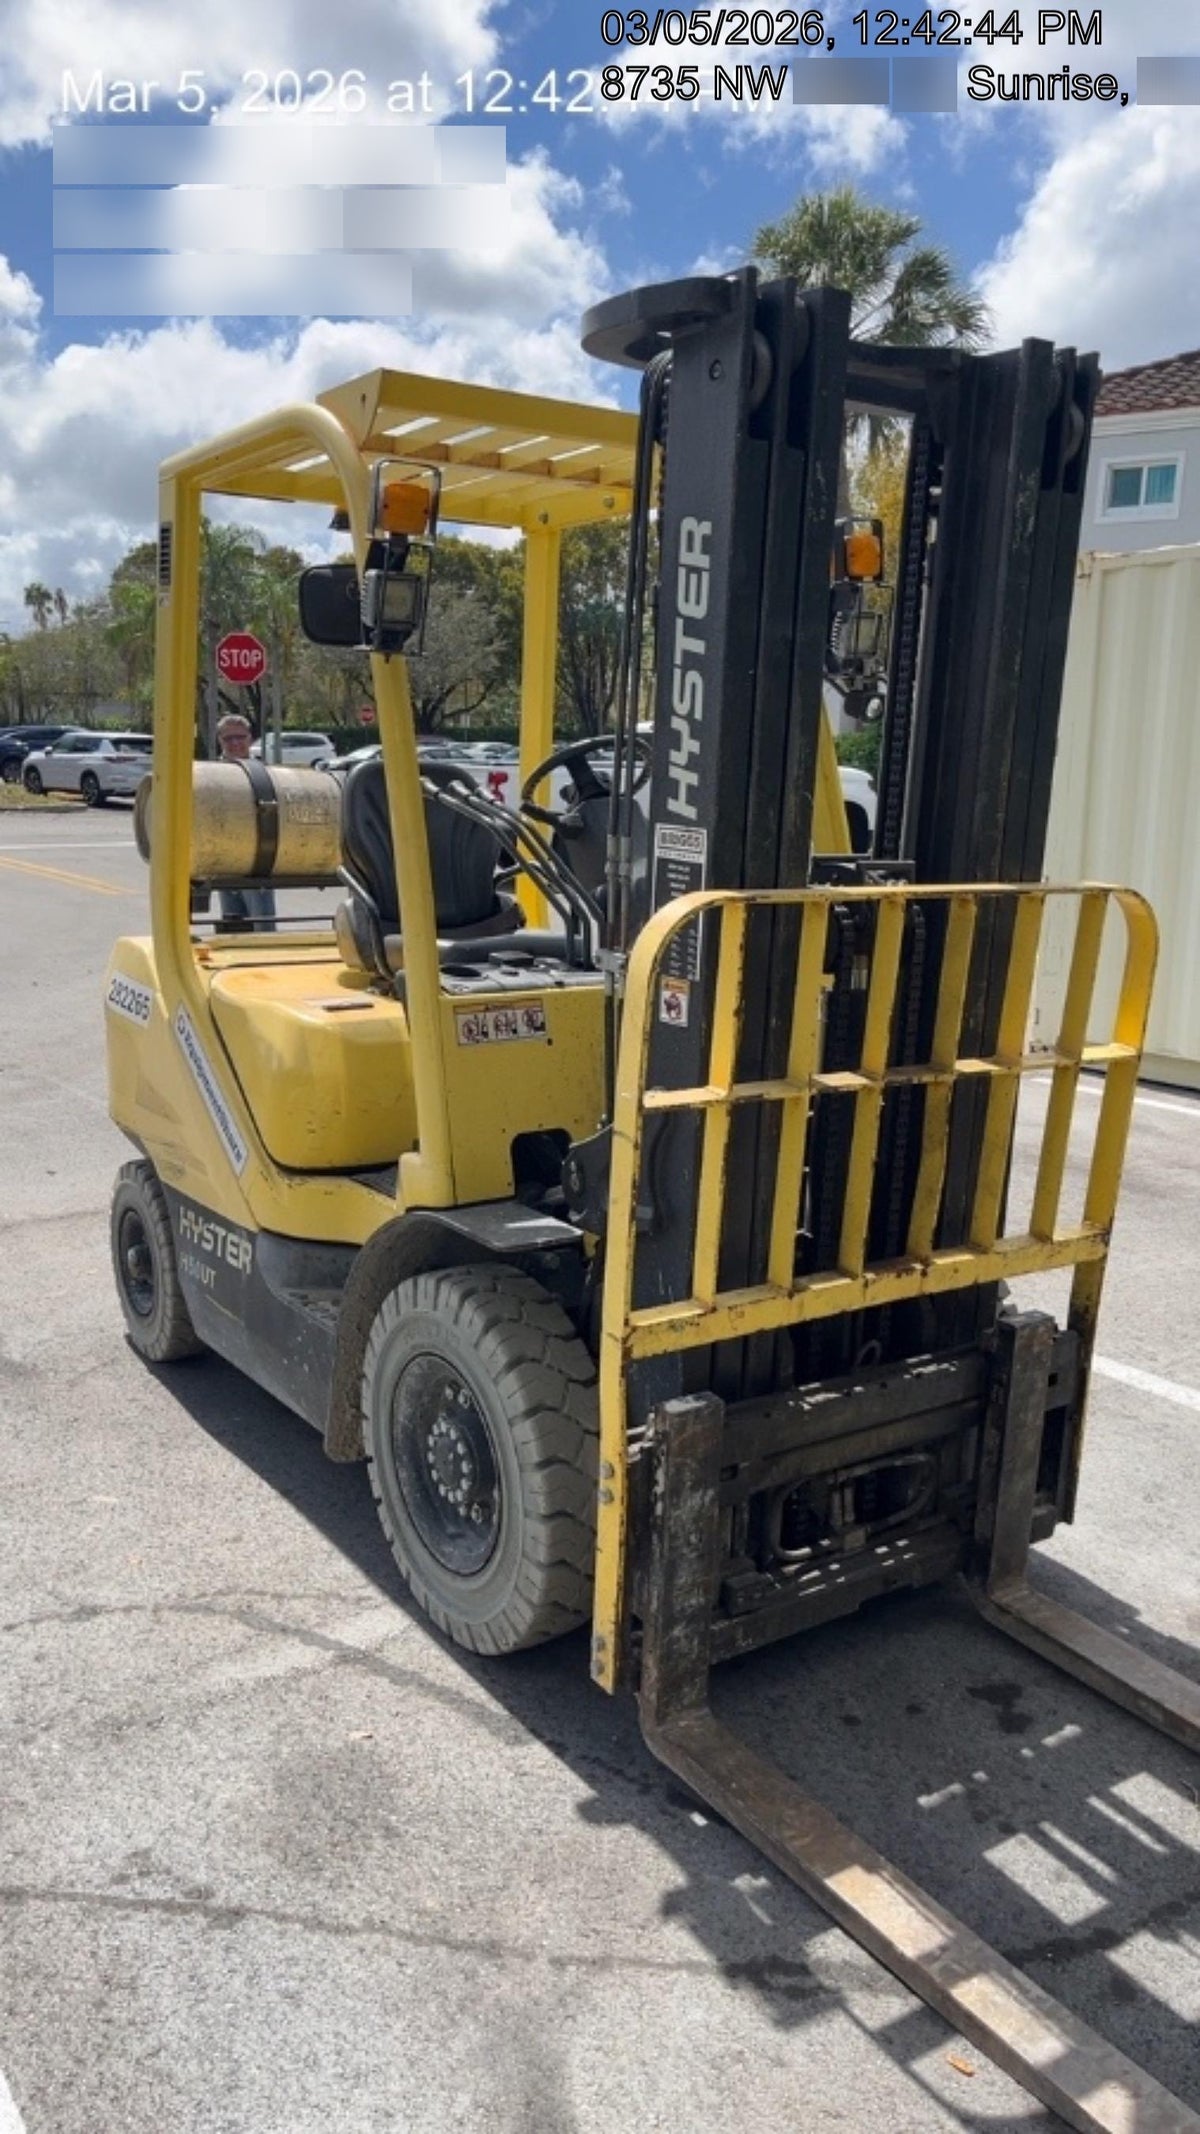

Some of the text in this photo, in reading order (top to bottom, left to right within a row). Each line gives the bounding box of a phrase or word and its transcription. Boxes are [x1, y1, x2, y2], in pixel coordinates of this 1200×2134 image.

[220, 648, 262, 668] STOP
[666, 515, 712, 821] HYSTER
[660, 831, 701, 849] BRIGGS
[180, 1206, 253, 1275] HYSTER
